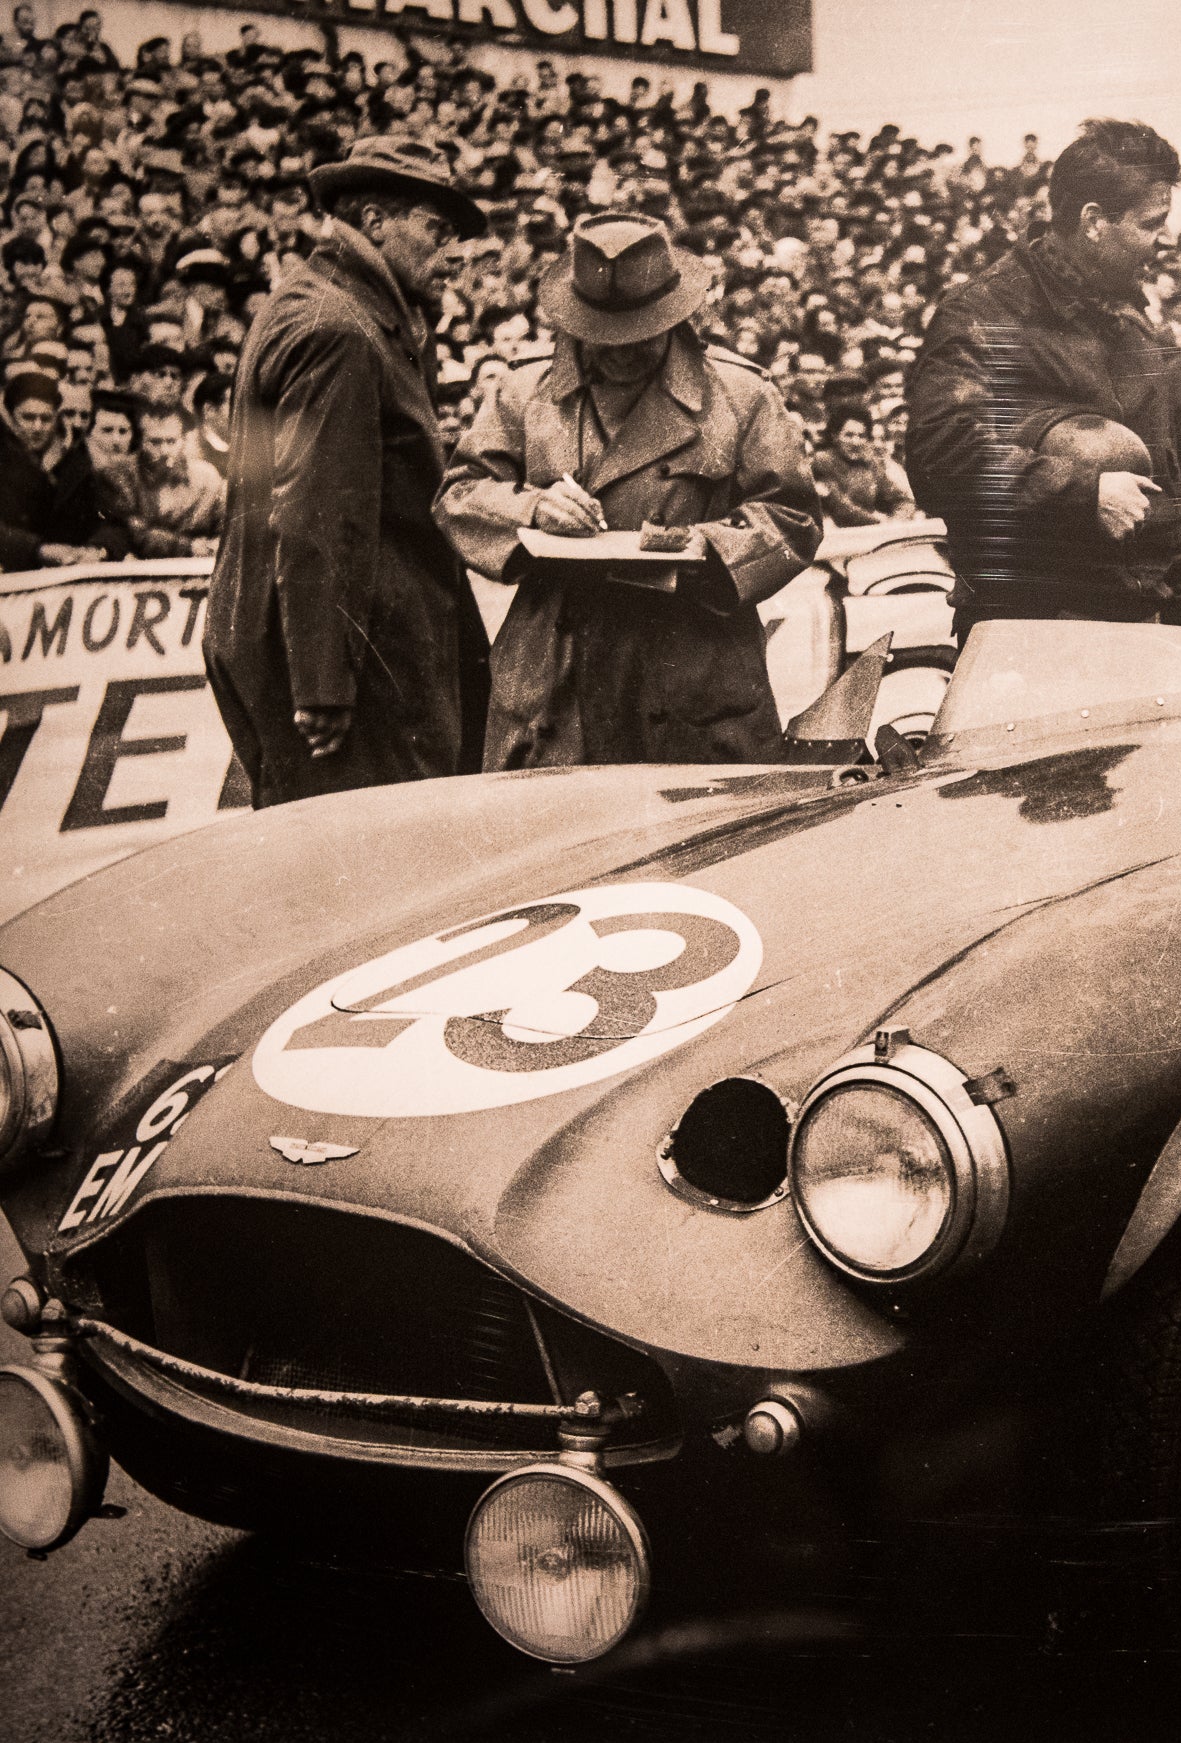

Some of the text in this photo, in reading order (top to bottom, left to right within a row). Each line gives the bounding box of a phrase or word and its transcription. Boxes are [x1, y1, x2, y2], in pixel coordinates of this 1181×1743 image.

[325, 0, 741, 55] RCHAL
[0, 674, 252, 833] TE
[282, 902, 741, 1073] 23
[135, 1063, 234, 1143] 6
[57, 1112, 190, 1232] EM
